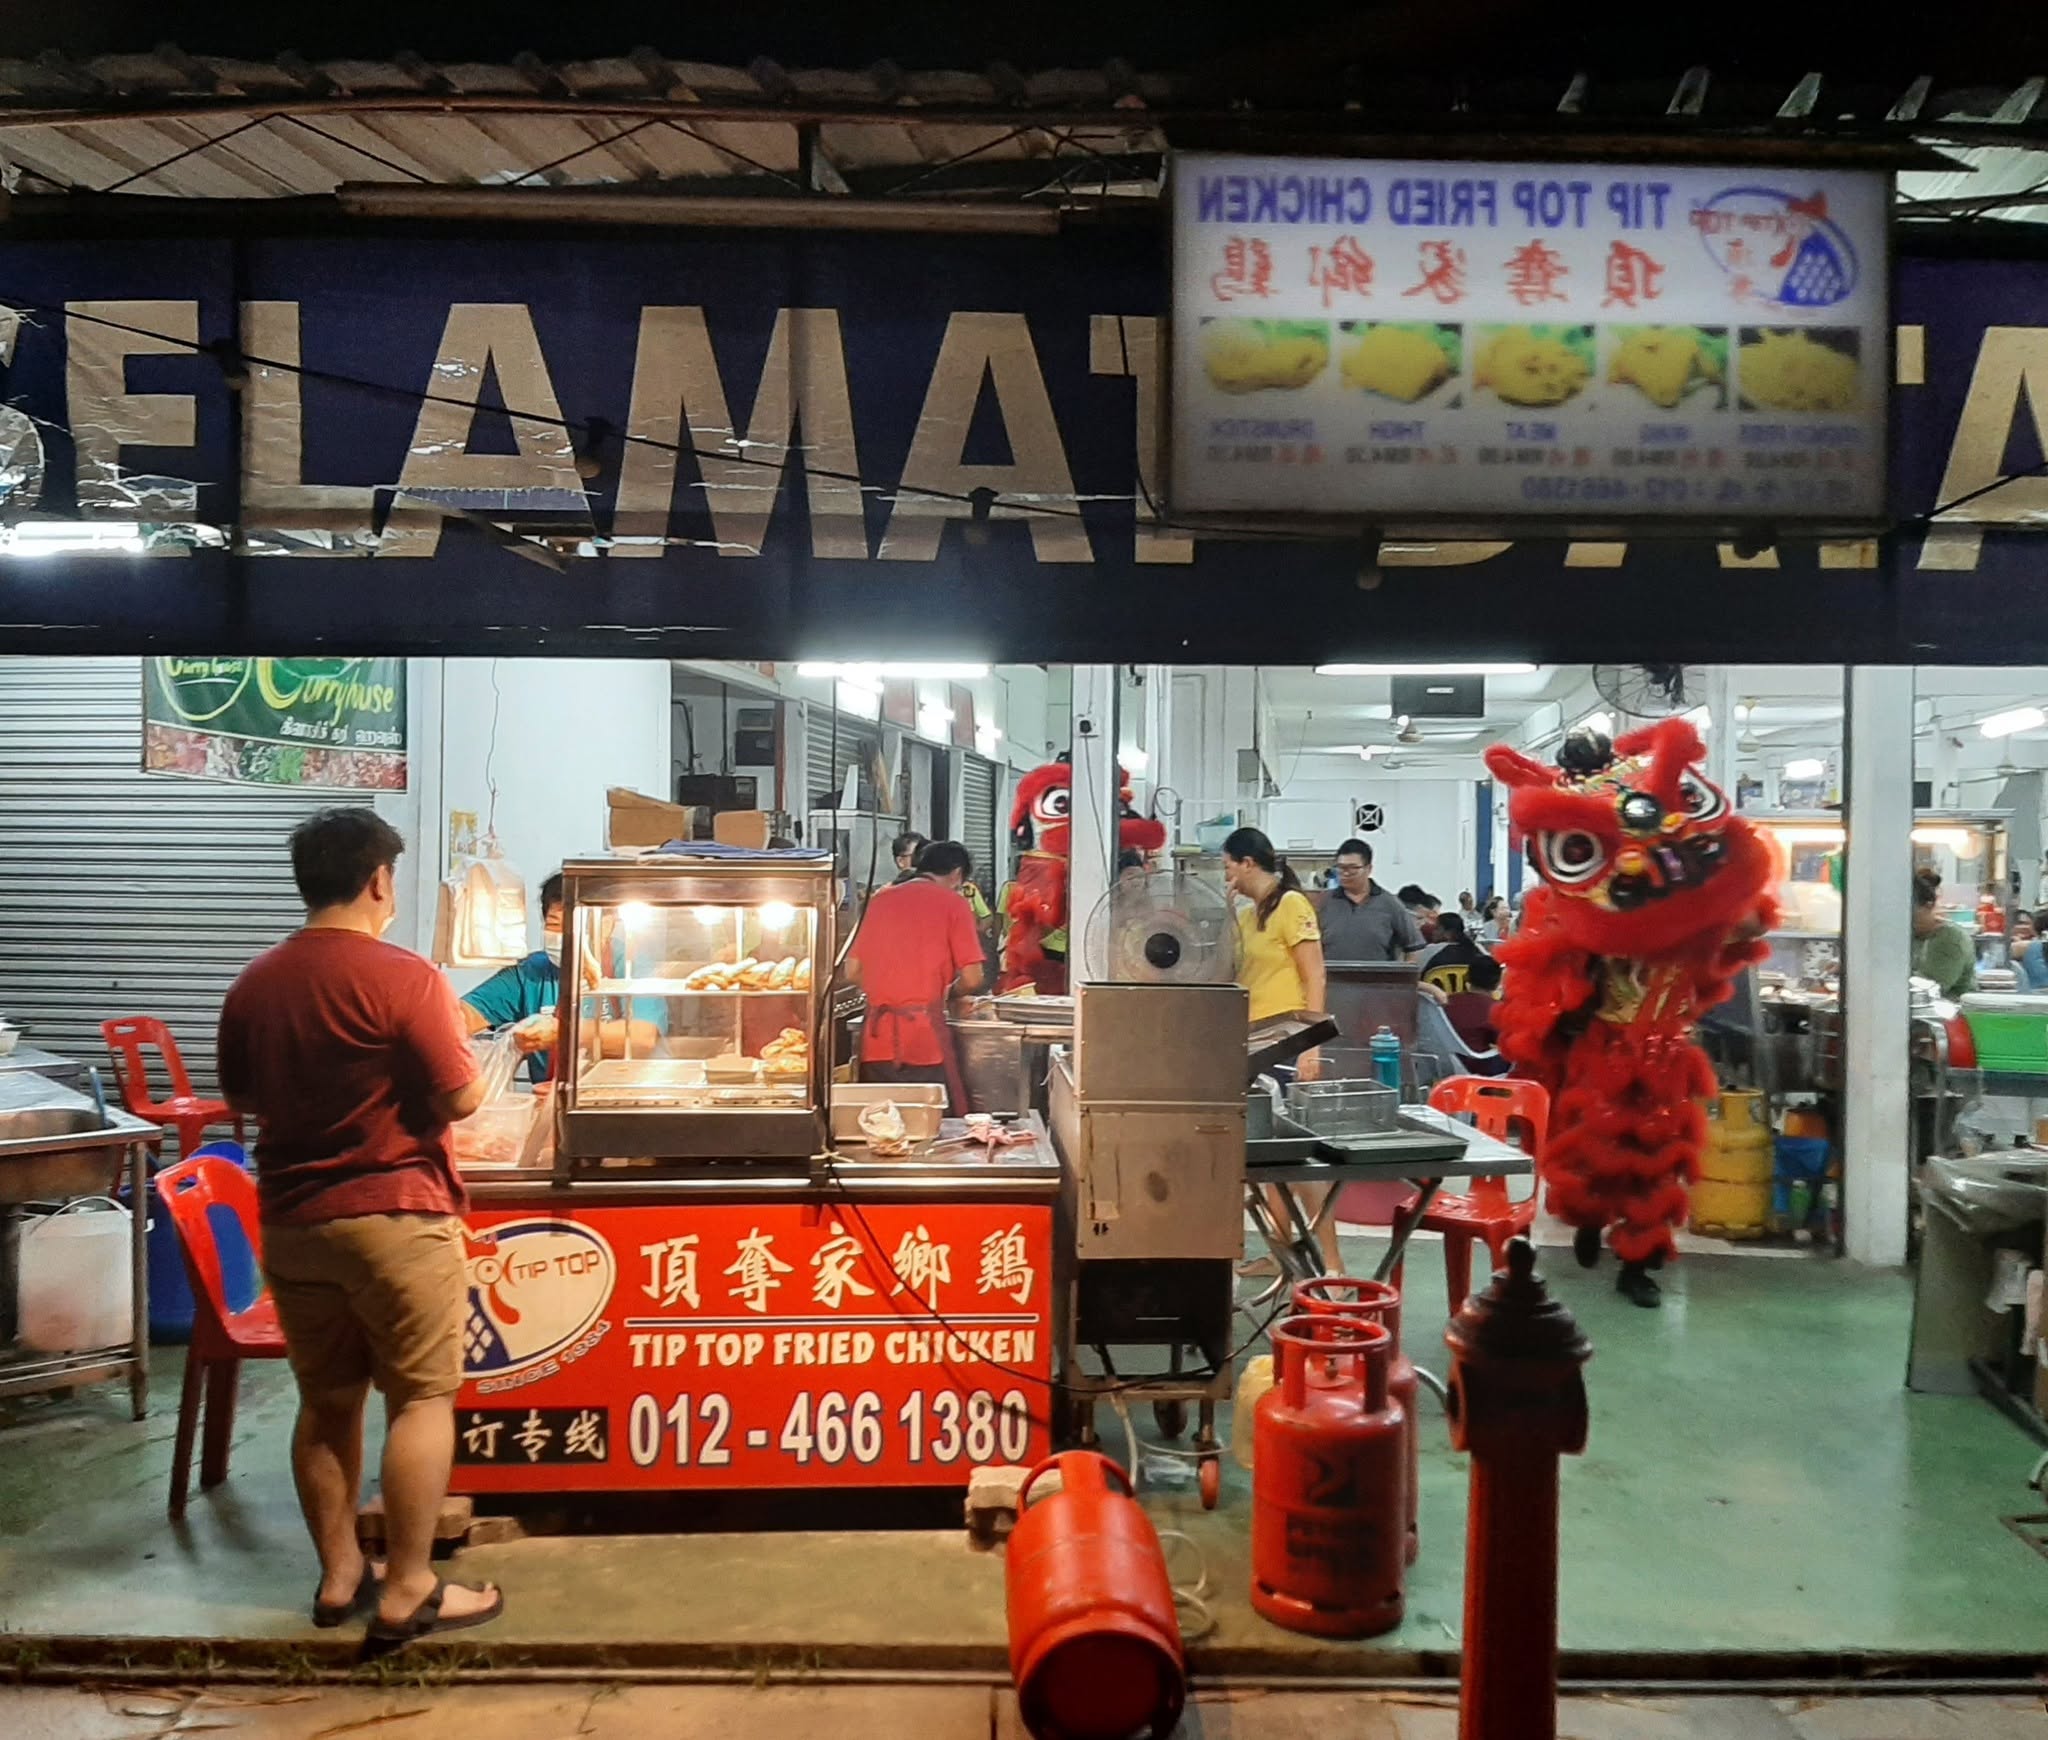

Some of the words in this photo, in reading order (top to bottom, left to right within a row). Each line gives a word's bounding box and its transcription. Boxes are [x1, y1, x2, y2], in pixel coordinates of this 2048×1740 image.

[0, 300, 1194, 563] ELAMAT
[513, 1260, 549, 1280] TIP
[553, 1249, 600, 1277] TOP
[475, 1358, 561, 1395] SINCE
[560, 1318, 613, 1365] 1984
[629, 1334, 686, 1367] TIP
[694, 1333, 765, 1367] TOP
[773, 1331, 875, 1366] FRIED
[884, 1329, 1036, 1364] CHICKEN
[628, 1391, 732, 1466] 012
[780, 1390, 882, 1464] 466
[899, 1389, 1030, 1463] 1380
